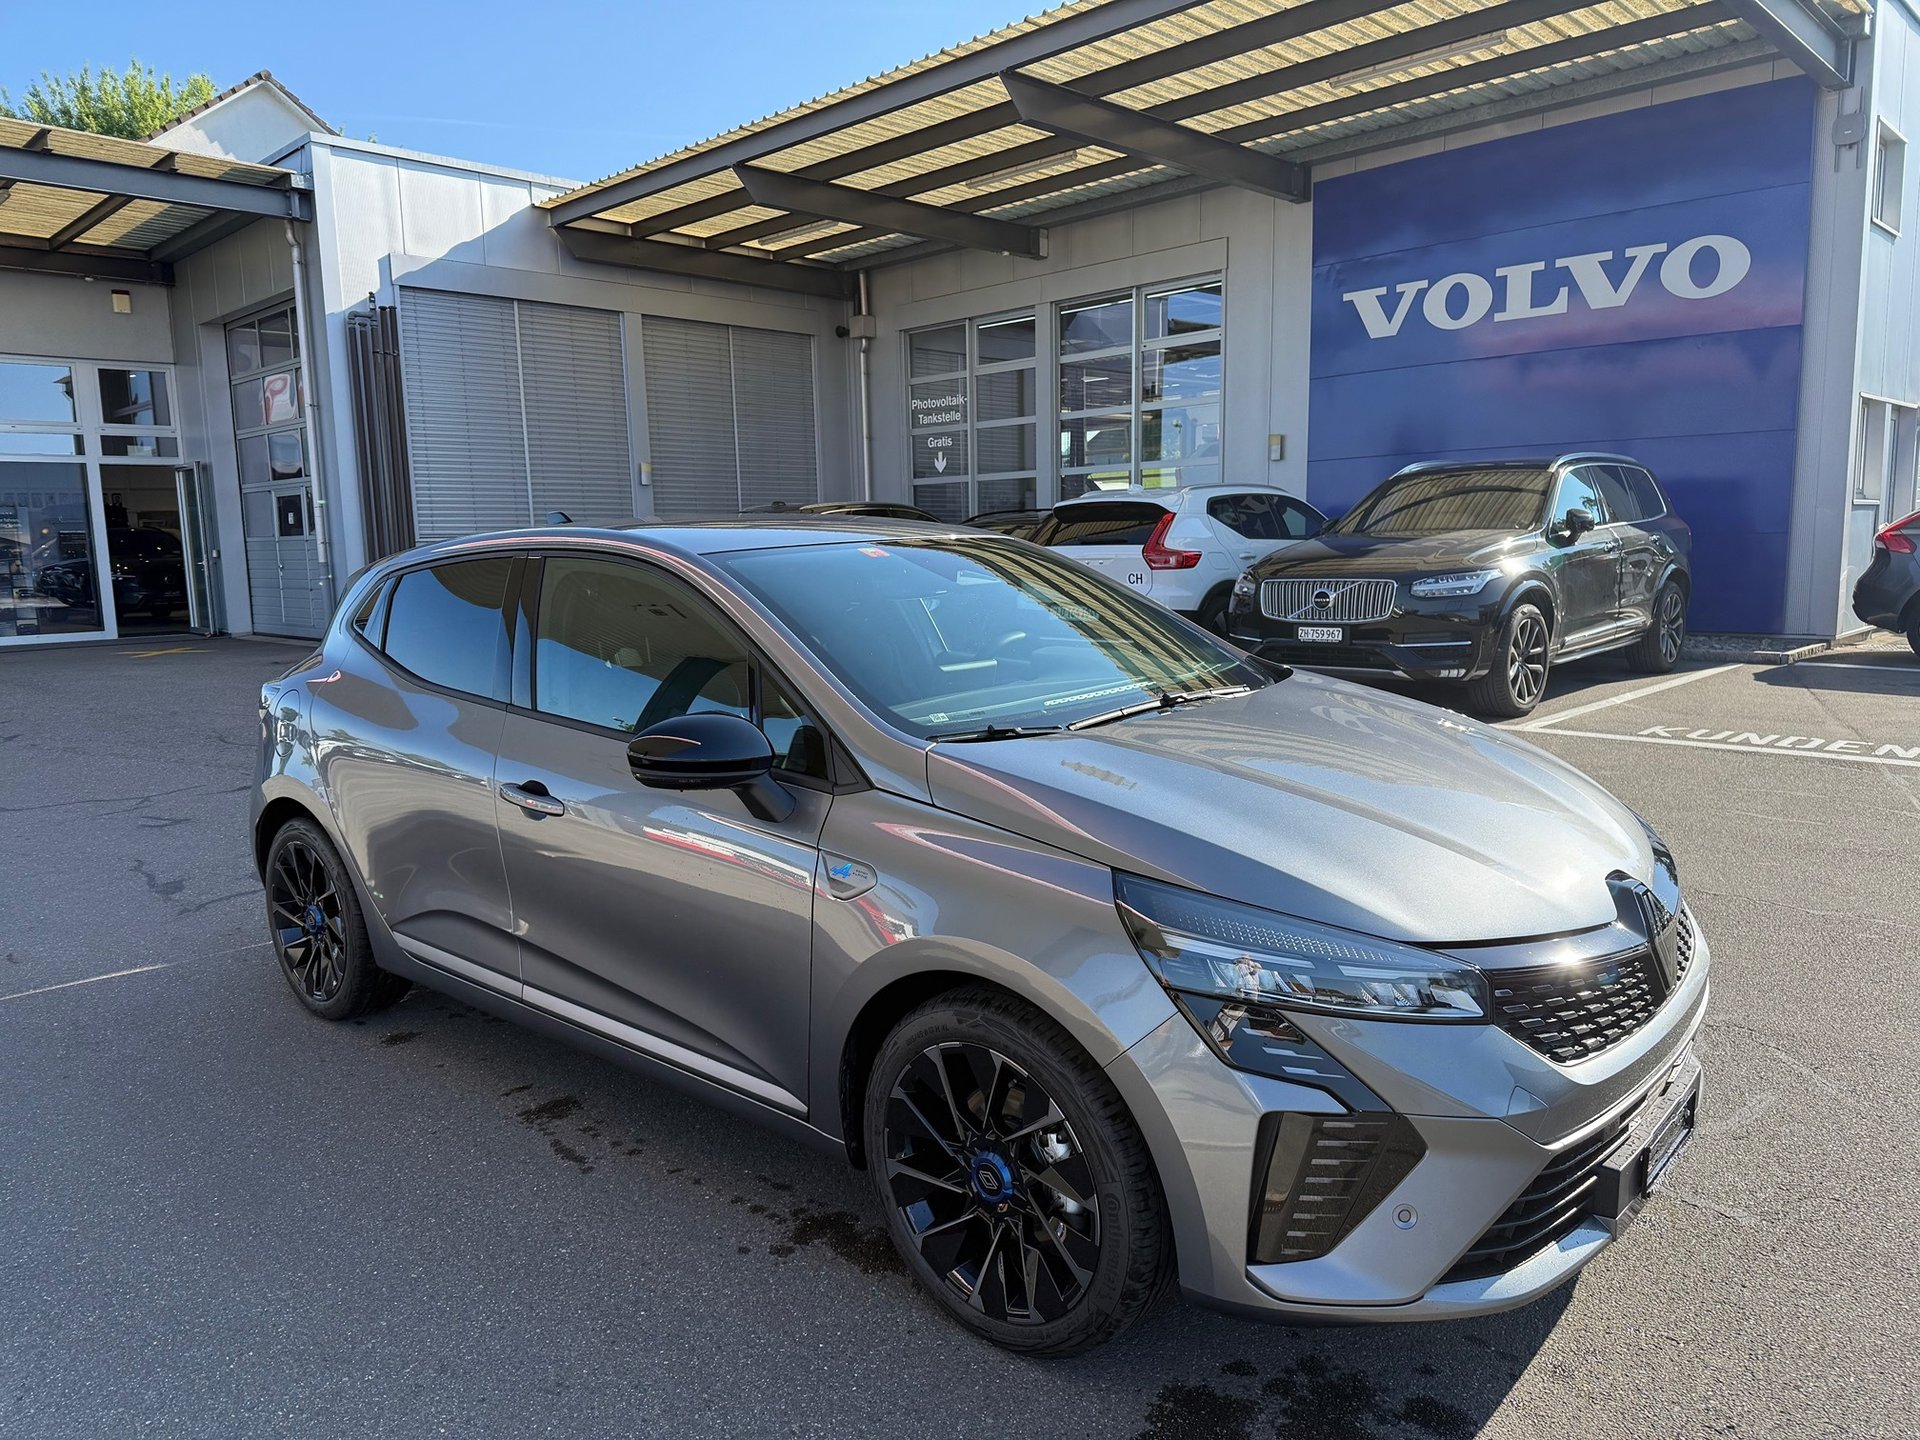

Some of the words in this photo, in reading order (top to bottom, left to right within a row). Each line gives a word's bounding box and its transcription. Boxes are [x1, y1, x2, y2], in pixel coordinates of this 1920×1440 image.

[1342, 234, 1752, 339] VOLVO
[911, 394, 967, 410] Photovoltaik-
[918, 410, 961, 425] Tankstelle
[927, 436, 953, 448] Gratis
[1128, 573, 1143, 584] CH
[1637, 725, 1920, 759] KUNDEN
